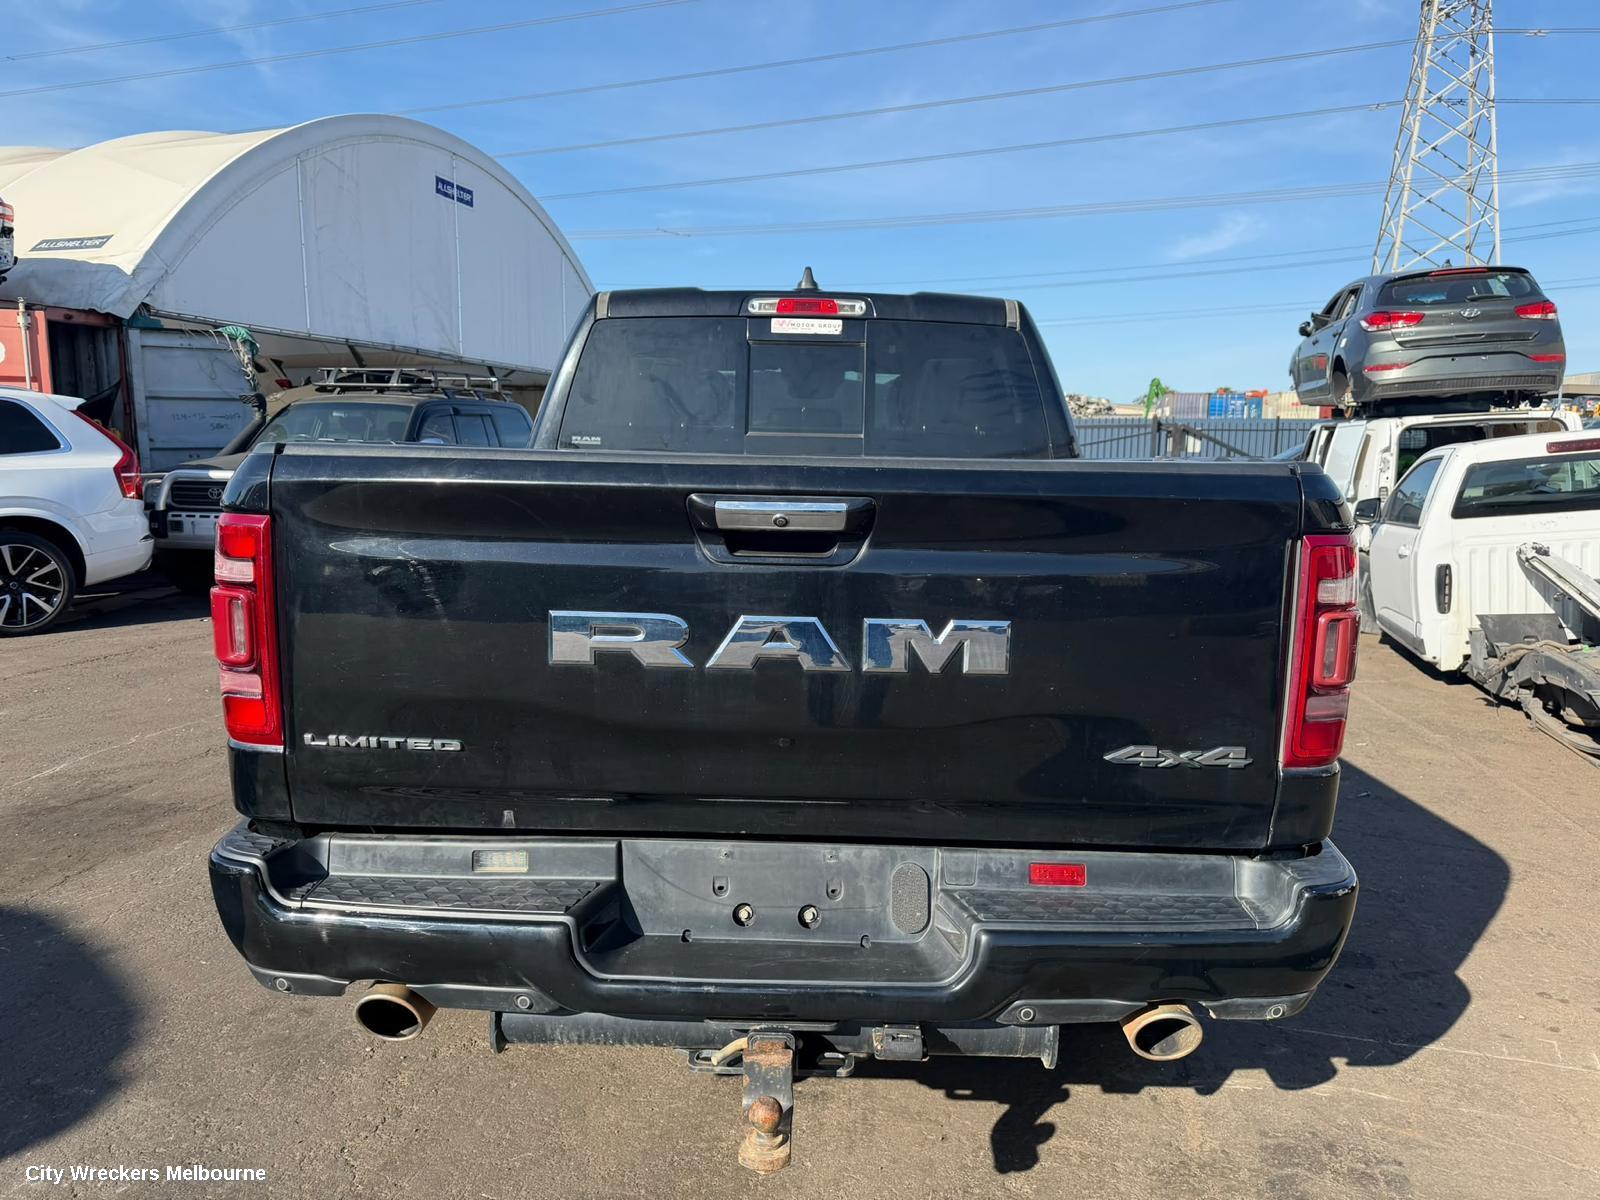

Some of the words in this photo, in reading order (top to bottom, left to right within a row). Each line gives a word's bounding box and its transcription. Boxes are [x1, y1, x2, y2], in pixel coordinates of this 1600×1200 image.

[548, 609, 1012, 675] RAM
[303, 732, 464, 751] LIMITED
[1103, 744, 1254, 769] 4x4
